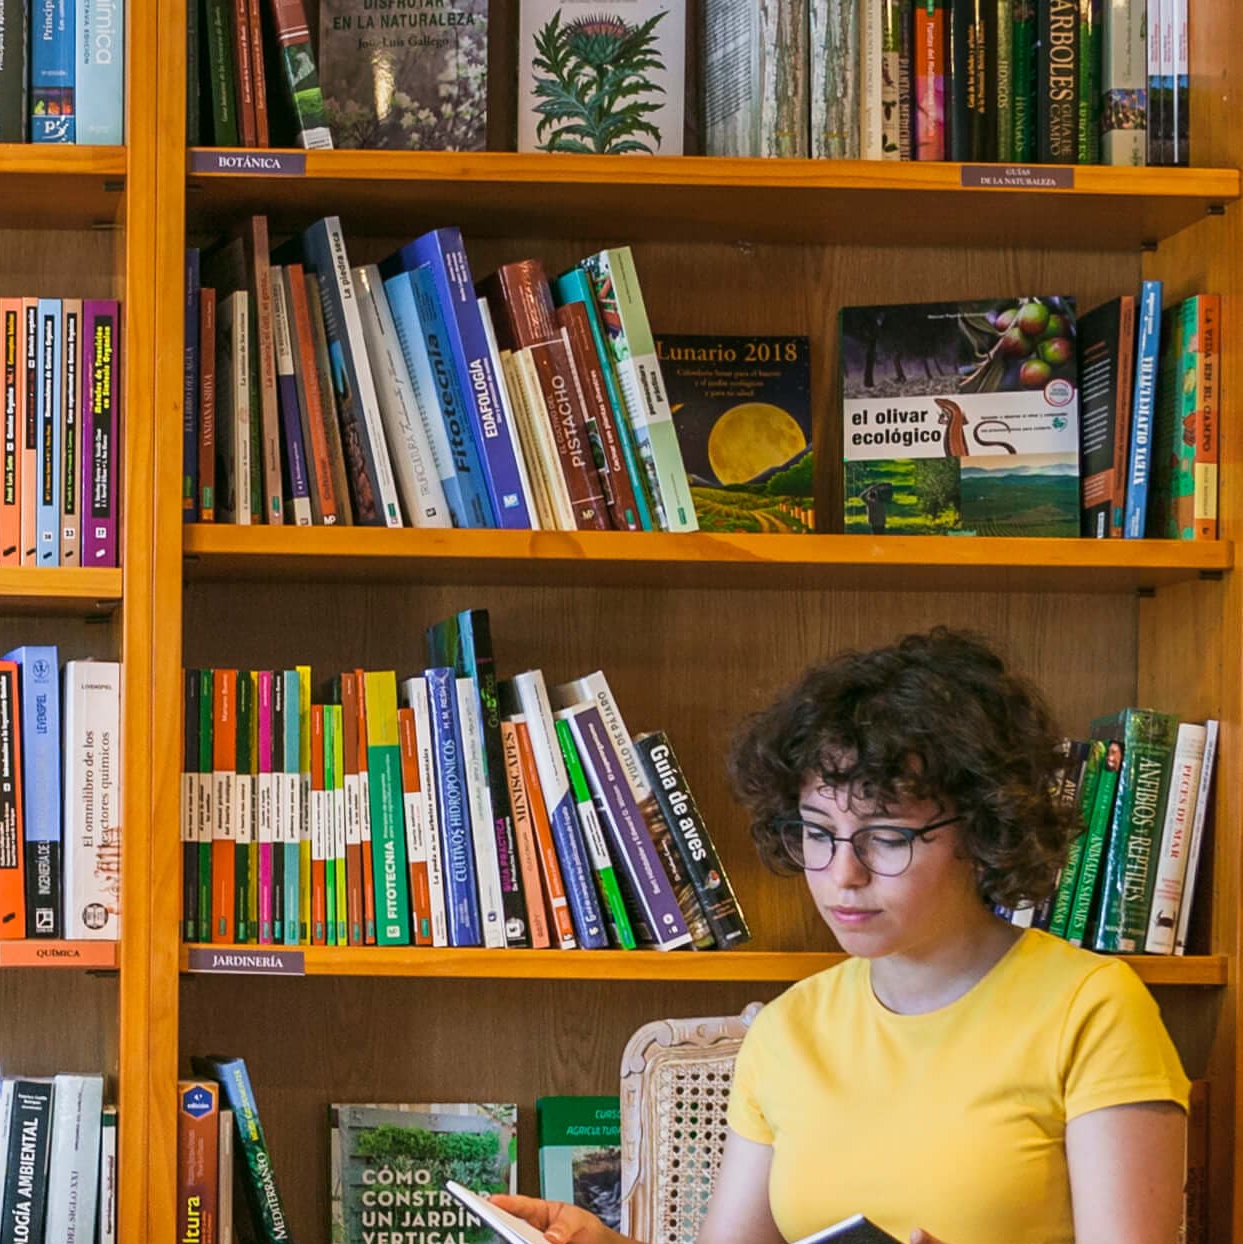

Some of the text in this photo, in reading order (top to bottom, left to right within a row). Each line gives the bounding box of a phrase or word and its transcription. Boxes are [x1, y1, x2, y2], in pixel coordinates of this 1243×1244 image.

[333, 11, 480, 30] EN LA NATURALEZA
[998, 60, 1009, 109] HONGOS
[1049, 0, 1079, 154] ÁRBOLES GUÍA DE
[1014, 96, 1027, 152] HONGOS
[1050, 103, 1061, 155] CAMPO
[218, 155, 281, 169] BOTÁNICA
[331, 231, 352, 299] La piedra seca
[94, 326, 103, 414] Metales de Transición
[657, 341, 797, 362] Lunario 2018
[426, 333, 472, 474] Fitotecnia
[468, 359, 500, 438] EDAFOLOGÍA
[637, 364, 656, 416] permacultura
[1202, 308, 1213, 452] LA VIDA EN EL CAMPO
[203, 373, 213, 446] VANDANA SHIVA
[552, 375, 586, 468] PISTACHO
[852, 408, 928, 425] el olivar
[1133, 355, 1154, 485] NUEVA OLIVICULTURA
[852, 428, 942, 446] ecológico
[35, 693, 49, 734] LEVENSPIEL
[439, 686, 450, 708] RESH
[99, 732, 113, 789] químicos
[597, 690, 645, 789] A VUELO DE PÁJARO
[82, 730, 95, 848] El omnilibro de los
[441, 739, 463, 827] HIDROPÓNICOS
[503, 731, 528, 824] MINISCAPES
[650, 744, 675, 790] Guía
[668, 791, 687, 815] de
[1170, 764, 1192, 859] PECES DE MAR
[453, 828, 468, 882] CULTIVOS
[677, 817, 707, 862] aves
[36, 844, 51, 895] INGENIERÍA DE
[383, 840, 399, 920] FITOTECNIA
[1073, 833, 1103, 928] ANIMALES SALVAJES
[37, 949, 80, 958] QUÍMICA
[212, 955, 284, 968] JARDINERÍA
[19, 1117, 39, 1198] AMBIENTAL
[70, 1170, 79, 1189] XXI
[362, 1164, 432, 1185] CÓMO
[67, 1191, 78, 1222] SIGLO
[362, 1206, 482, 1228] UN JARDÍN
[65, 1223, 76, 1244] DEL
